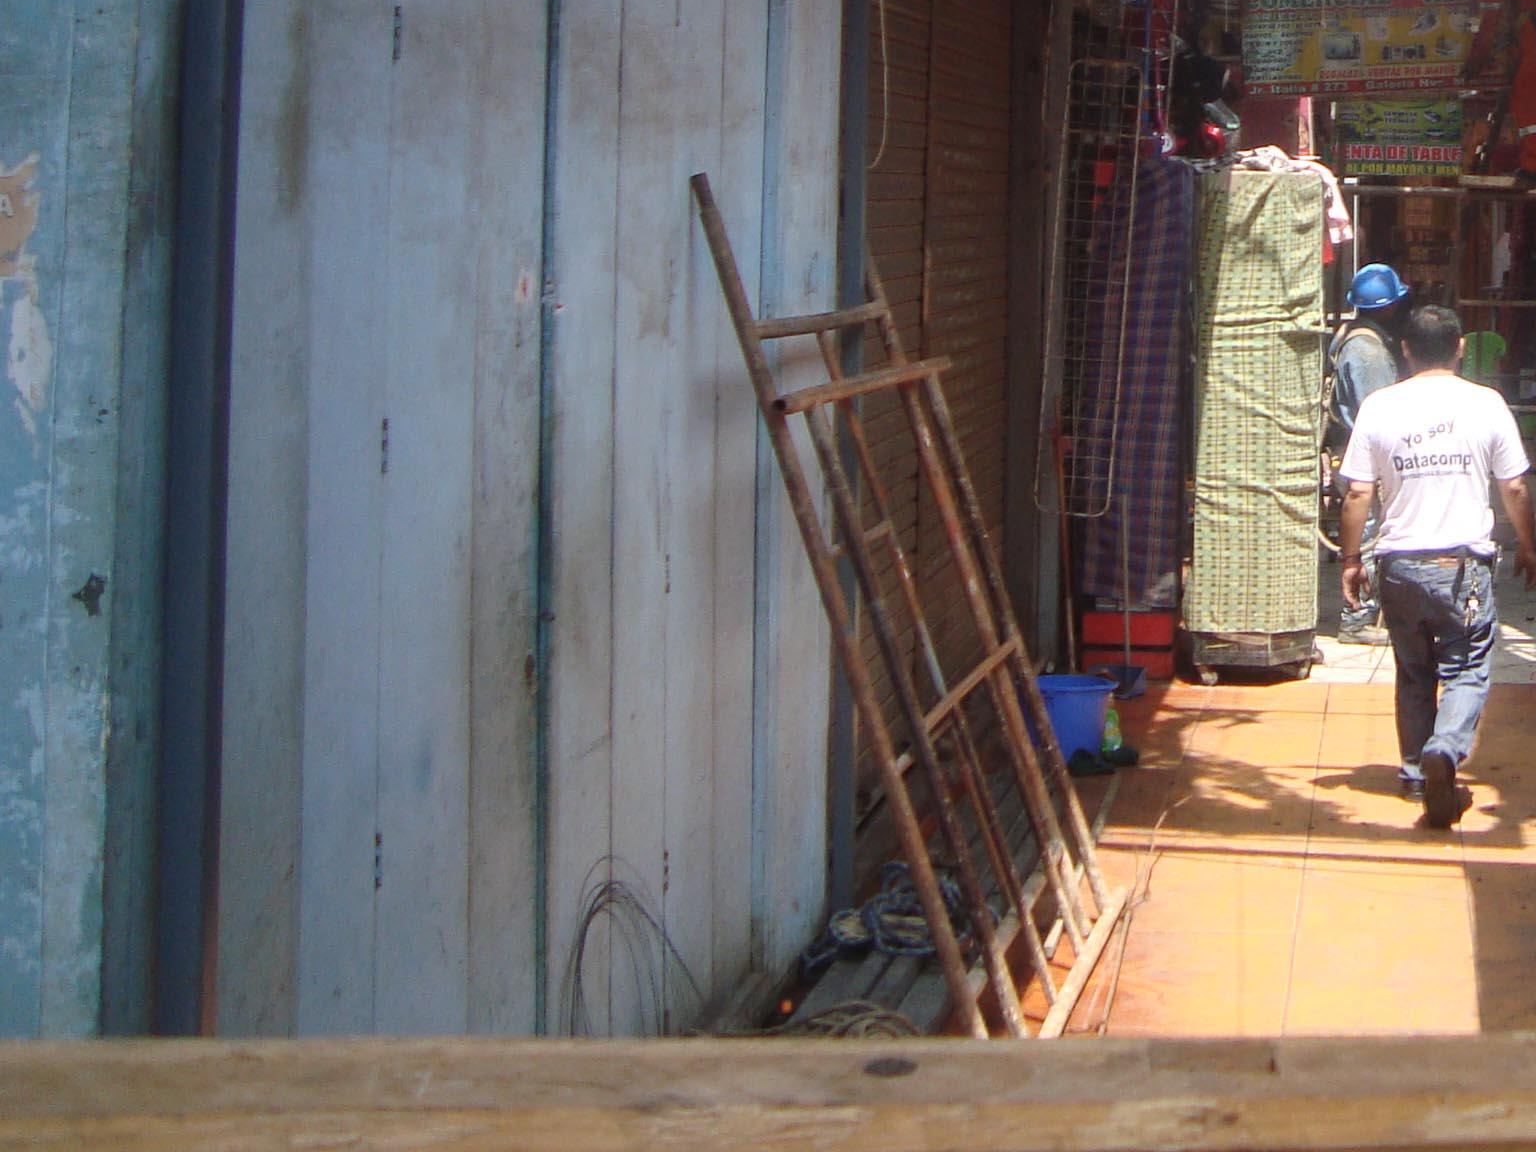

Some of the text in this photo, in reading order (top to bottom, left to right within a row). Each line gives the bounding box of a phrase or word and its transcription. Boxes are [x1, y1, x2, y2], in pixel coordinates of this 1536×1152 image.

[1386, 144, 1408, 160] DE
[1361, 163, 1383, 174] POR
[1386, 163, 1425, 175] MAYOR
[1401, 418, 1456, 449] Yo soy
[1392, 452, 1473, 472] Datacomp
